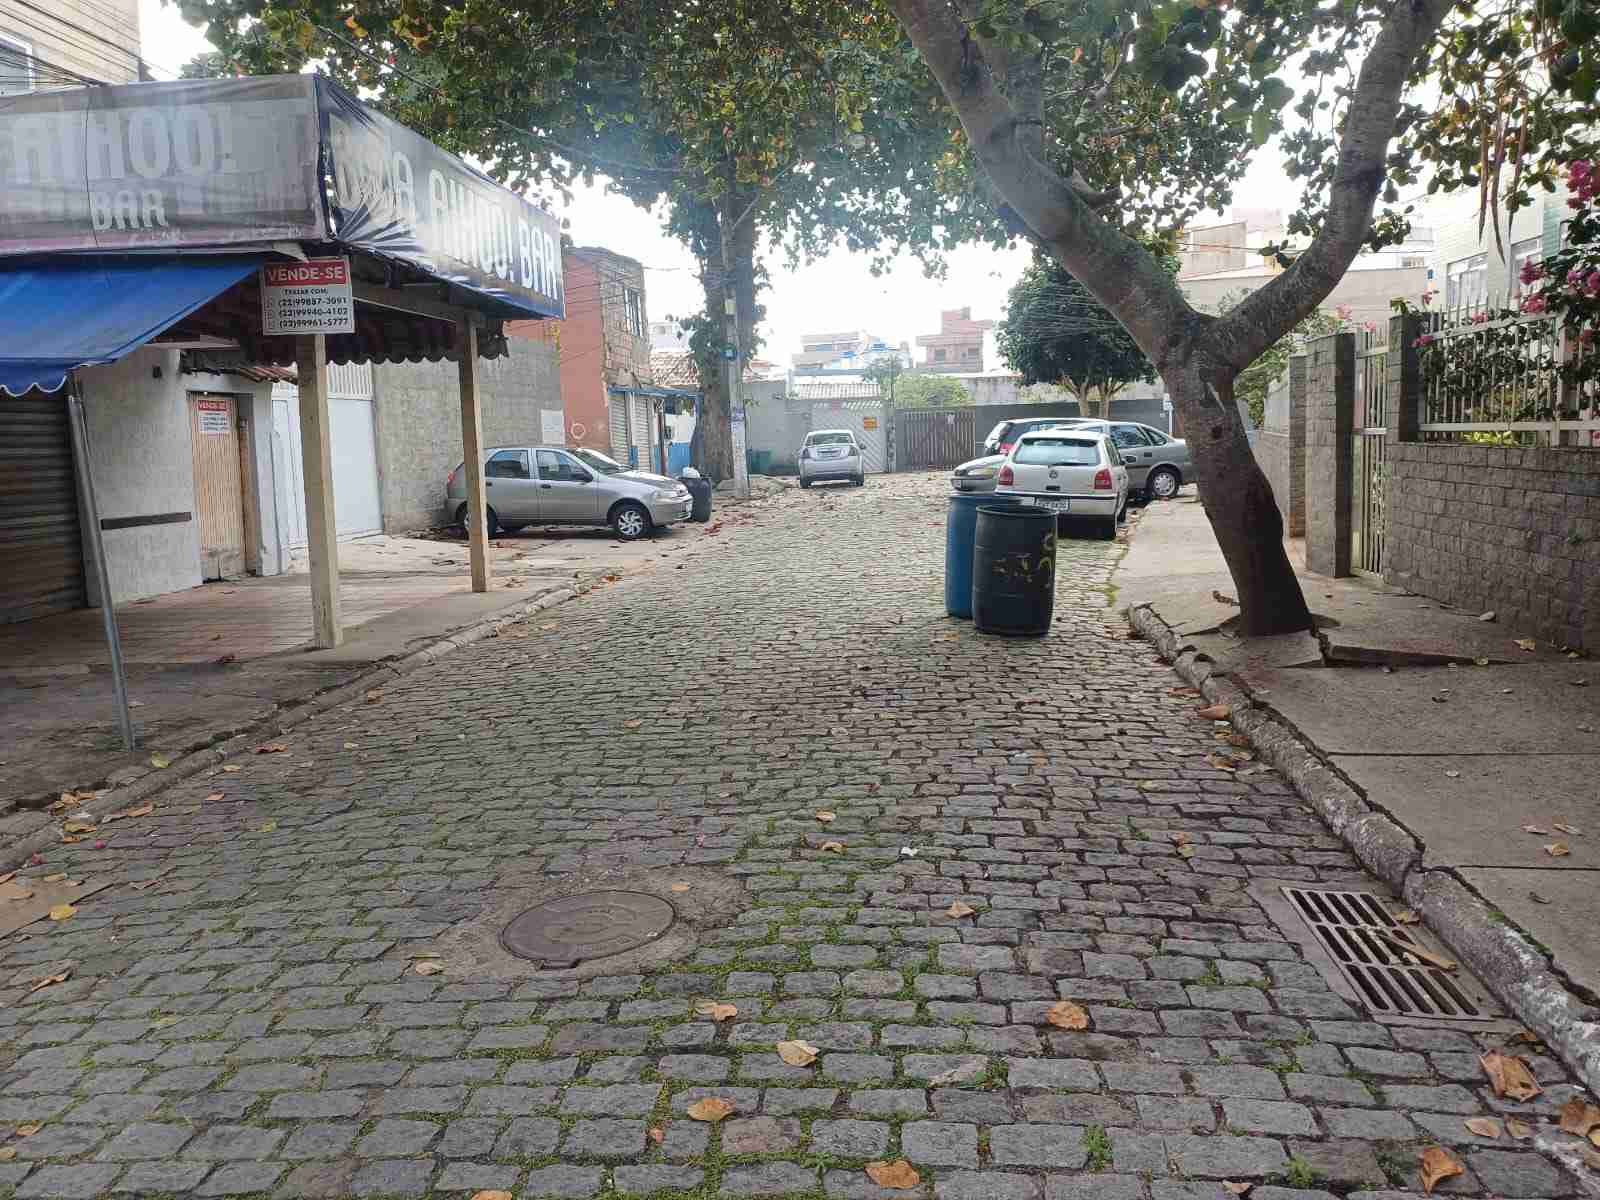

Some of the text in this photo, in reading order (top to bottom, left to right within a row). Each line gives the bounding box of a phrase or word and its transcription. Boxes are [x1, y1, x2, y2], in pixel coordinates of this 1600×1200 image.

[90, 189, 169, 230] BAR
[268, 266, 343, 281] VENDE-SE
[519, 216, 559, 300] BAR
